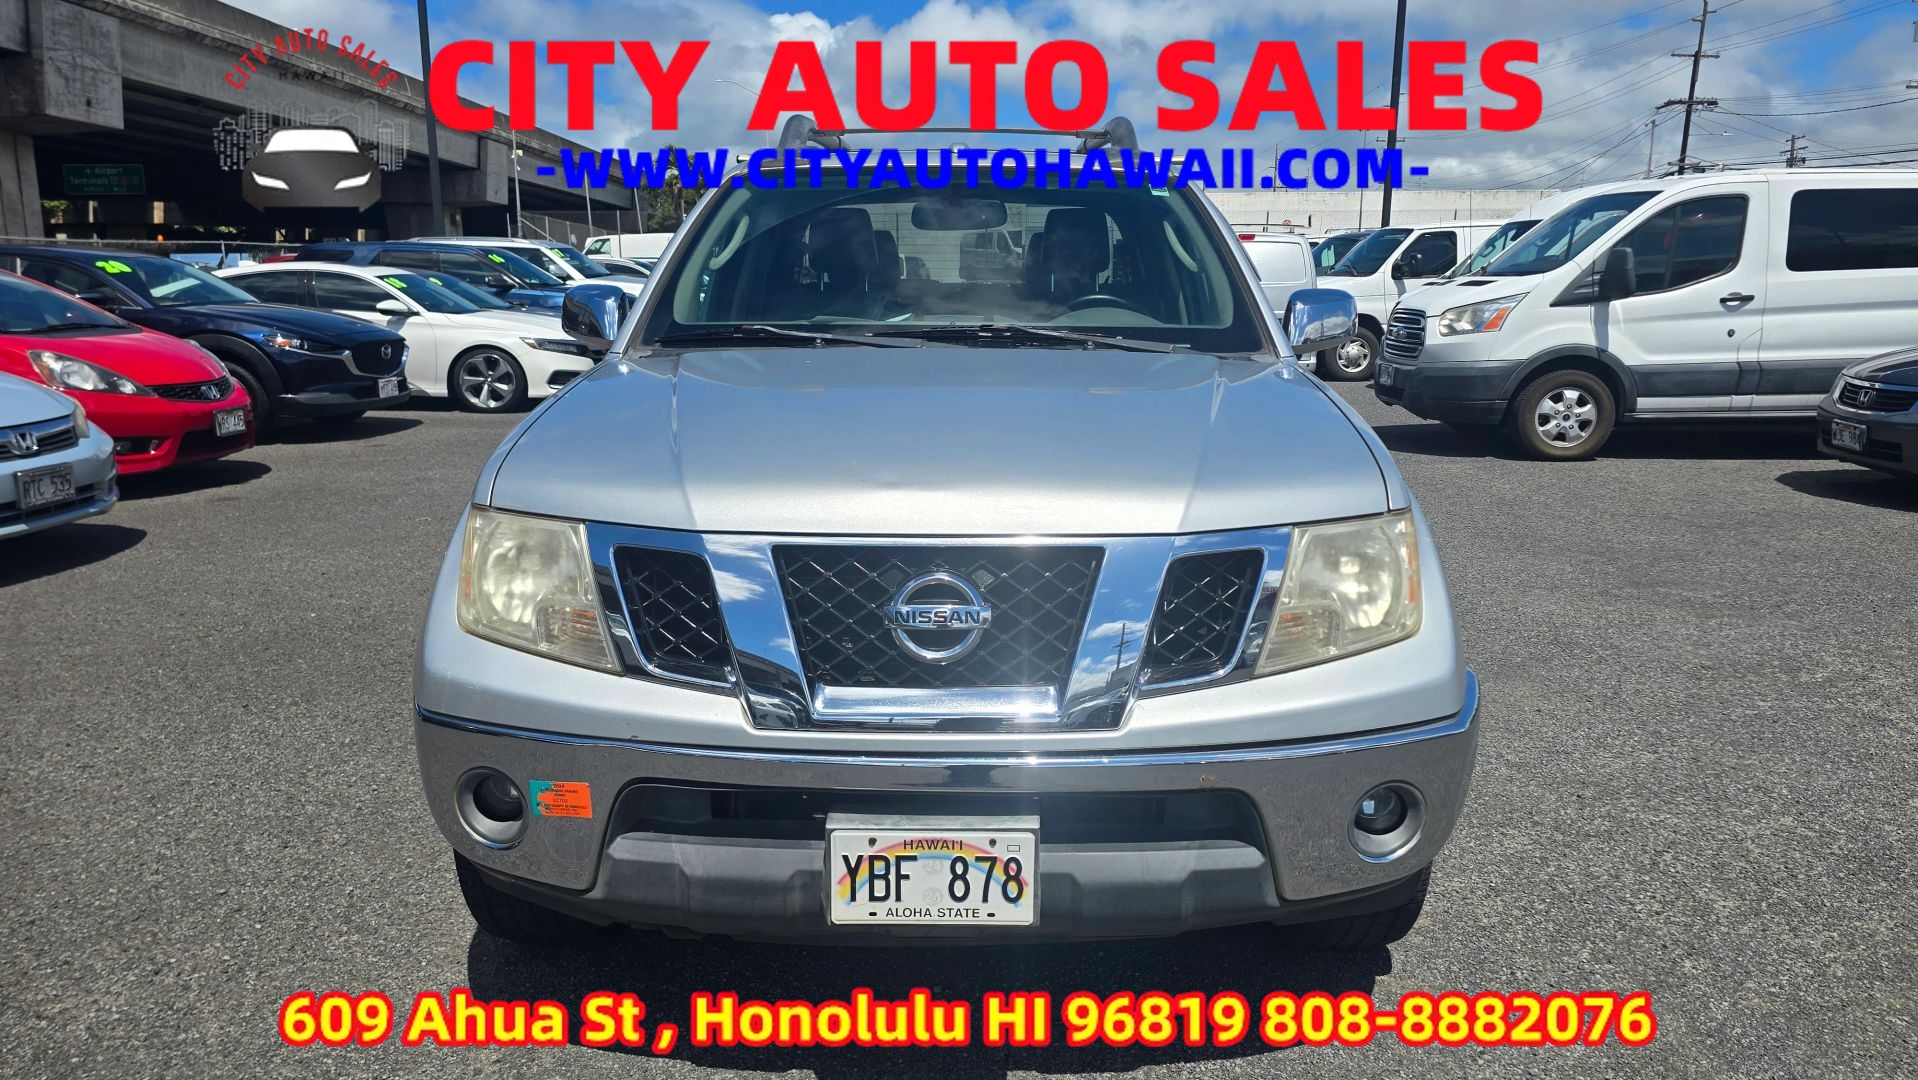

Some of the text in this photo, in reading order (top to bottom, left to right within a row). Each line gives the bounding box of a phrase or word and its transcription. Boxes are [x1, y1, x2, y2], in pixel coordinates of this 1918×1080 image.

[95, 260, 133, 273] 20
[23, 473, 72, 499] RTC 535
[894, 610, 981, 624] NISSAN
[841, 854, 1024, 903] YBF 878
[885, 907, 980, 918] ALOHA STATE
